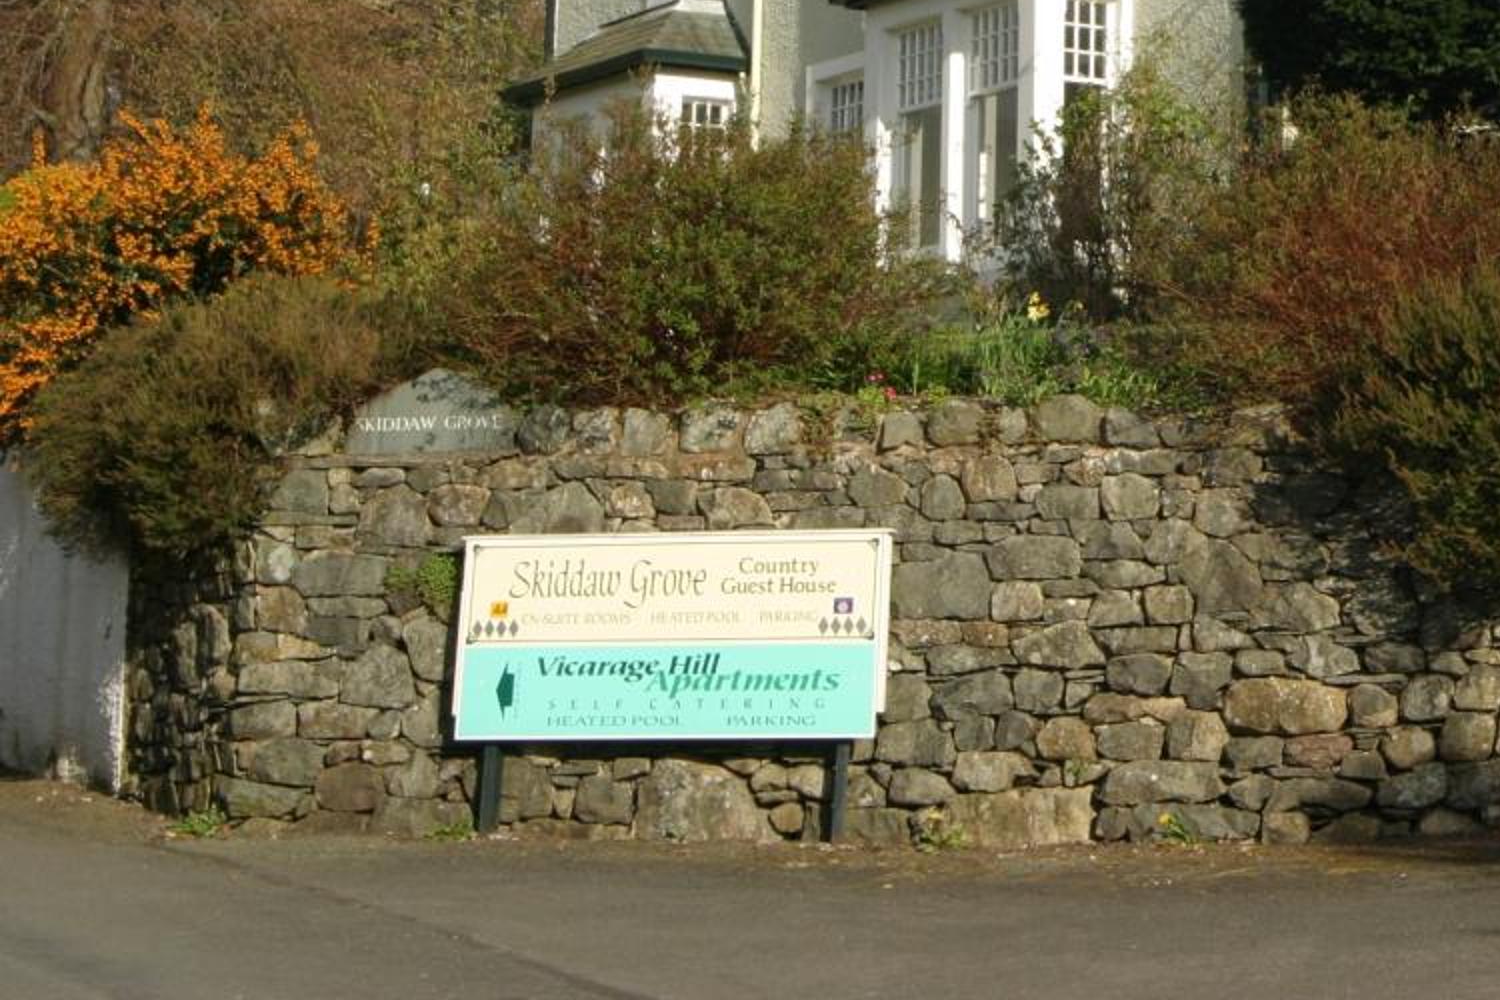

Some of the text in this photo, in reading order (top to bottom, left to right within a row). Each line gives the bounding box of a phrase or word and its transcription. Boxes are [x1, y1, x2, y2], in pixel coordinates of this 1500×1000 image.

[444, 413, 505, 430] GROVE
[738, 557, 819, 576] Country
[508, 558, 707, 609] Skiddaw Grove
[720, 576, 838, 596] Guest House
[538, 652, 721, 684] Vicarage Hill
[644, 668, 842, 701] Apartments
[547, 714, 684, 727] HEATED POOL
[726, 714, 817, 727] PARKING
